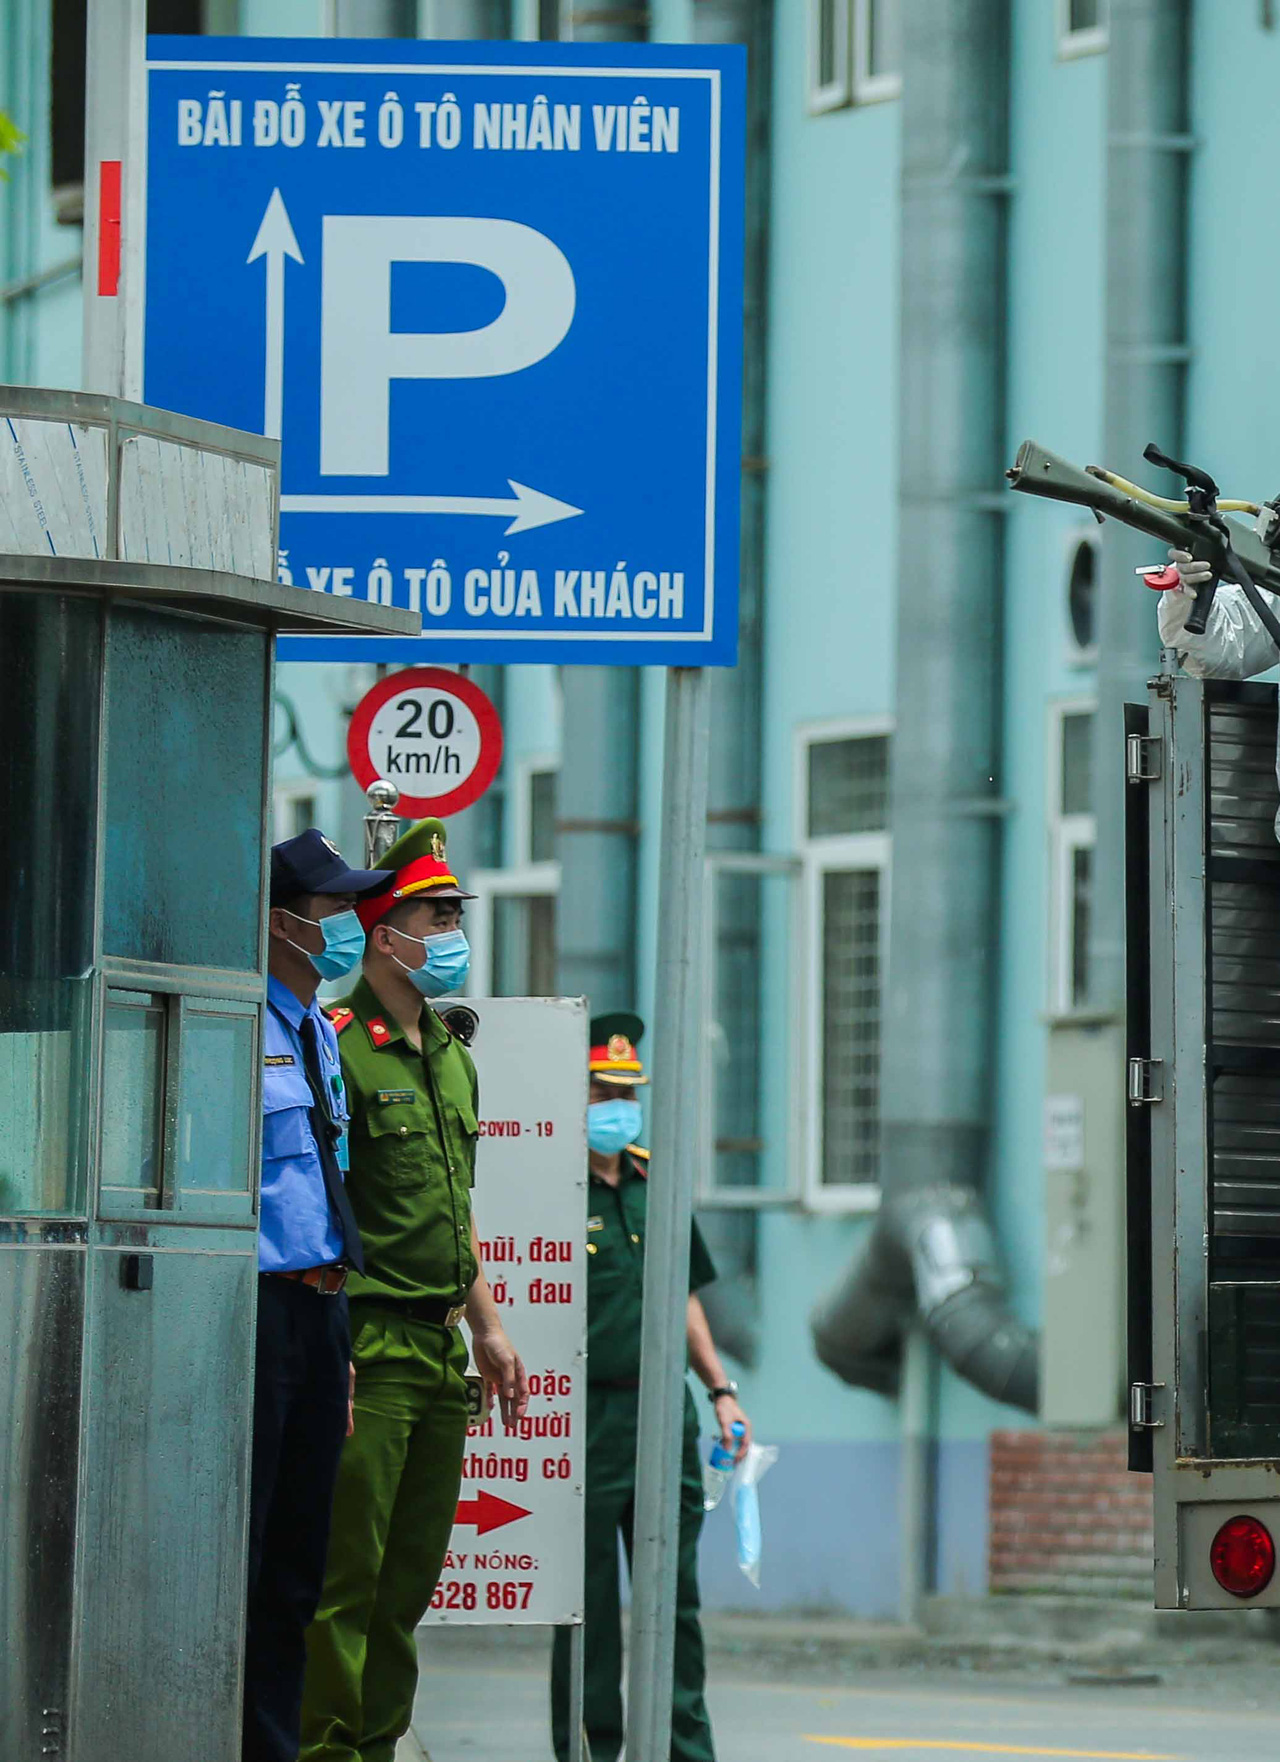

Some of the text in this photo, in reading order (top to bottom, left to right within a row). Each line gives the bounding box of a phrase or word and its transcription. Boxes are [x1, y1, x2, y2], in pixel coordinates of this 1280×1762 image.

[178, 84, 680, 152] BÃI ĐỖ XE Ô TÔ NHÂN VIÊN
[320, 215, 576, 476] P
[404, 559, 452, 616] TÔ
[464, 551, 541, 618] CỦA
[554, 562, 684, 619] KHÁCH
[395, 698, 454, 739] 20
[386, 745, 461, 774] km/h
[478, 1121, 520, 1137] COVID
[536, 1121, 553, 1137] 19
[529, 1236, 572, 1262] đau
[487, 1274, 572, 1307] ở, đau
[527, 1369, 572, 1402] oặc
[542, 1452, 571, 1479] có
[443, 1549, 539, 1570] ÂY NÓNG:
[430, 1581, 534, 1610] 528 867
